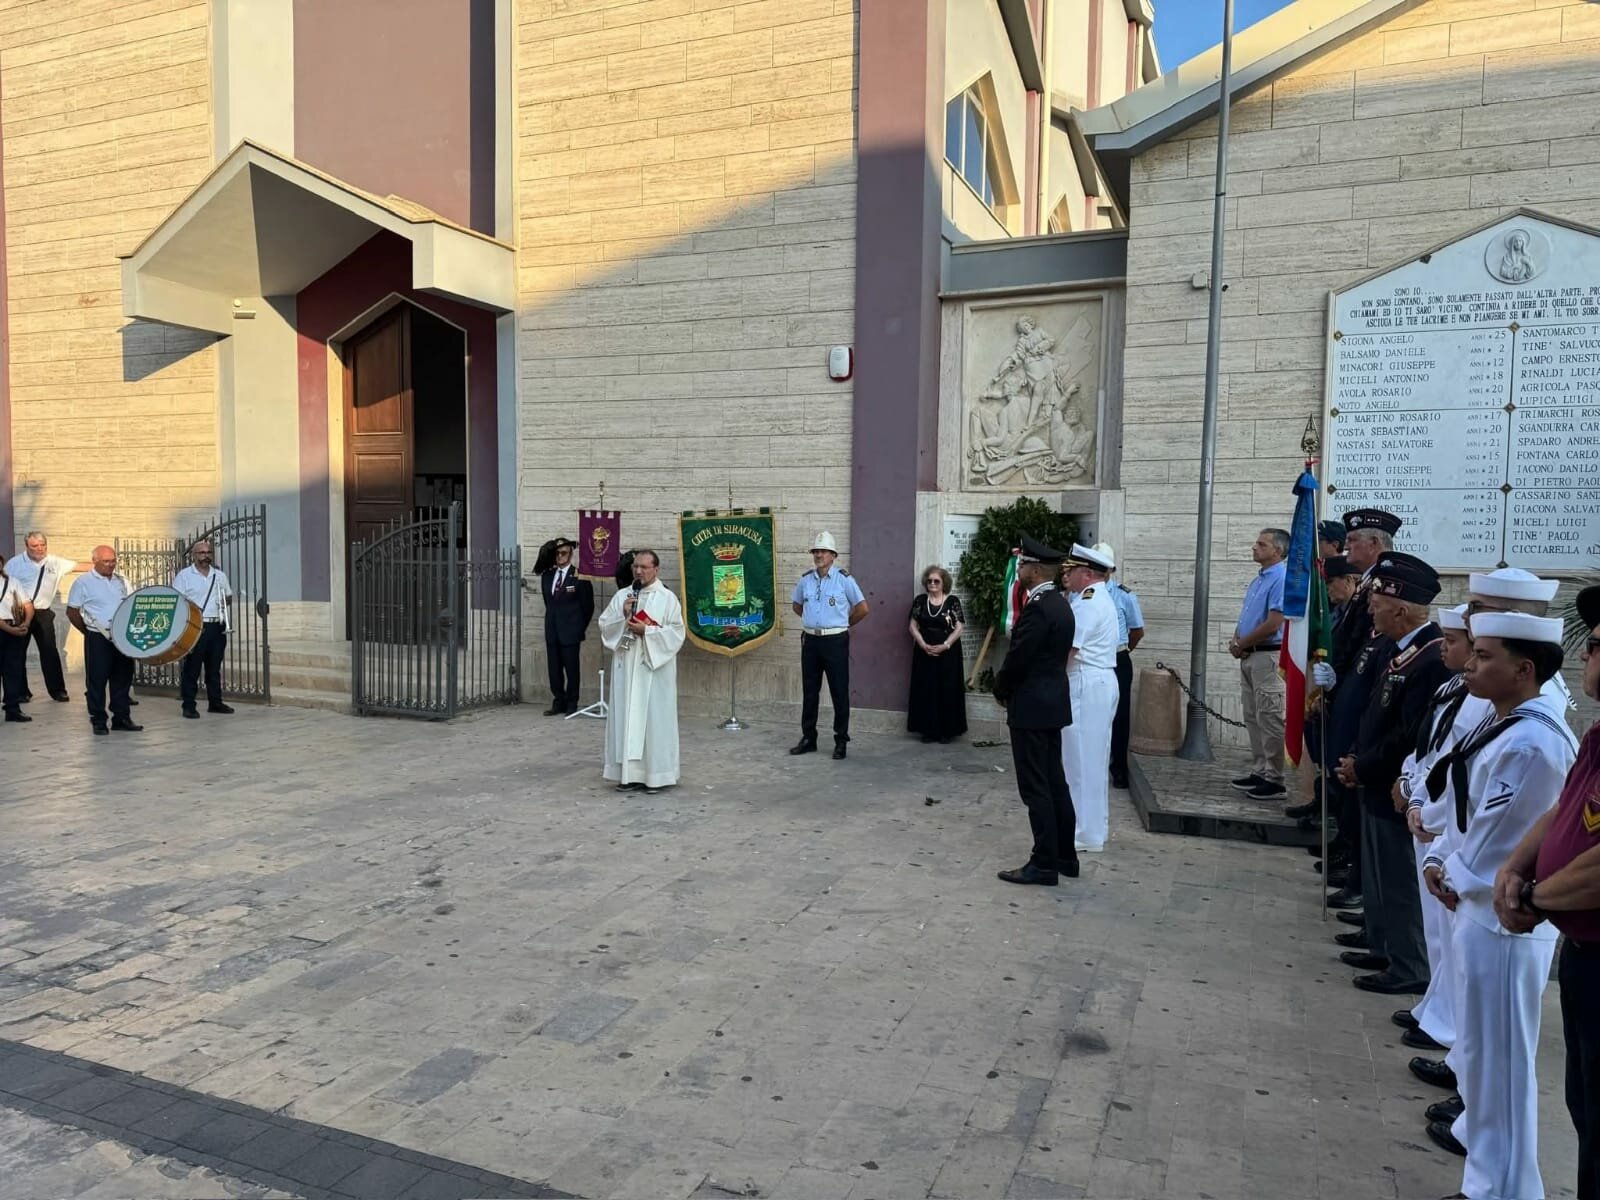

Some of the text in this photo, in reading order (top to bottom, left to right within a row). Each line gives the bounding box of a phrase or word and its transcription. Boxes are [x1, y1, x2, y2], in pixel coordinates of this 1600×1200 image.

[1394, 288, 1410, 296] SONO
[1361, 300, 1372, 308] NON
[1376, 299, 1391, 307] SONO
[1428, 295, 1443, 304] SONO
[1446, 293, 1481, 303] SOLAMENTE
[1485, 292, 1513, 301] PASSATO
[1516, 290, 1557, 299] DALL'ALTRA
[1350, 310, 1379, 318] CHIAMAMI
[1383, 309, 1390, 317] ED
[1394, 308, 1402, 316] IO
[1405, 307, 1412, 315] TI
[1416, 306, 1435, 314] SARO'
[1469, 303, 1500, 312] CONTINUA
[1504, 302, 1508, 310] A
[1512, 300, 1536, 310] RIDERE
[1541, 300, 1548, 308] DI
[1552, 298, 1577, 308] QUELLO
[1580, 297, 1593, 305] CHE
[1366, 318, 1391, 328] ASCIUGA
[1395, 317, 1403, 326] LE
[1406, 317, 1418, 325] TUE
[1422, 315, 1448, 325] LACRIME
[1451, 315, 1455, 323] E
[1459, 314, 1471, 322] NON
[1475, 312, 1506, 322] PIANGERE
[1509, 311, 1518, 319] SE
[1522, 310, 1529, 319] MI
[1555, 309, 1562, 317] IL
[1566, 308, 1578, 316] TUO
[1582, 306, 1600, 316] SORR
[1523, 327, 1586, 337] SANTOMARCO
[1341, 337, 1374, 346] SIGONA
[1380, 335, 1414, 345] ANGELO
[1495, 331, 1506, 339] 25
[1522, 342, 1551, 351] TINE'
[1340, 350, 1380, 359] BALSAMO
[1385, 347, 1426, 357] DANIELE
[1499, 344, 1504, 352] 2
[1521, 355, 1553, 365] CAMPO
[1339, 362, 1383, 372] MINACORI
[1390, 361, 1436, 370] GIUSEPPE
[1494, 358, 1504, 366] 12
[1339, 376, 1377, 384] MICIELI
[1384, 374, 1429, 383] ANTONINO
[1494, 371, 1504, 380] 18
[1521, 369, 1563, 378] RINALDI
[1339, 389, 1366, 398] AVOLA
[1372, 388, 1412, 397] ROSARIO
[1492, 385, 1503, 393] 20
[1520, 382, 1570, 392] AGRICOLA
[1520, 395, 1593, 405] LUPICA LUIGI
[1365, 401, 1400, 409] ANGELO
[1354, 414, 1394, 423] MARTINO
[1400, 413, 1441, 421] ROSARIO
[1491, 411, 1501, 420] 17
[1519, 409, 1574, 419] TRIMARCHI
[1337, 428, 1365, 437] COSTA
[1371, 426, 1428, 436] SEBASTIANO
[1490, 425, 1501, 433] 20
[1519, 423, 1574, 432] SGANDURRA
[1336, 441, 1374, 449] NASTASI
[1381, 440, 1433, 448] SALVATORE
[1489, 439, 1500, 447] 21
[1518, 437, 1561, 446] SPADARO
[1336, 454, 1381, 462] TUCCITTO
[1388, 453, 1410, 461] IVAN
[1490, 452, 1500, 460] 15
[1517, 450, 1598, 459] FONTANA CARLO
[1335, 467, 1379, 475] MINACORI
[1386, 466, 1432, 474] GIUSEPPE
[1488, 465, 1499, 473] 21
[1518, 464, 1598, 473] IACONO DANILO
[1385, 479, 1431, 487] VIRGINIA
[1488, 478, 1499, 486] 20
[1516, 477, 1526, 486] DI
[1534, 477, 1571, 486] PIETRO
[1334, 492, 1368, 500] RAGUSA
[1374, 492, 1402, 500] SALVO
[1487, 492, 1497, 500] 21
[1515, 491, 1570, 500] CASSARINO
[1373, 505, 1418, 513] MARCELLA
[1486, 505, 1497, 513] 33
[1514, 505, 1556, 513] GIACONA
[1485, 518, 1497, 526] 29
[1513, 518, 1586, 526] MICELI LUIGI
[724, 525, 762, 545] SIRACUSA
[1485, 531, 1495, 540] 21
[1513, 531, 1579, 540] TINE' PAOLO
[1394, 544, 1428, 552] VUCCIO
[1484, 545, 1495, 553] 19
[1512, 545, 1600, 554] CICCIARELLA AL
